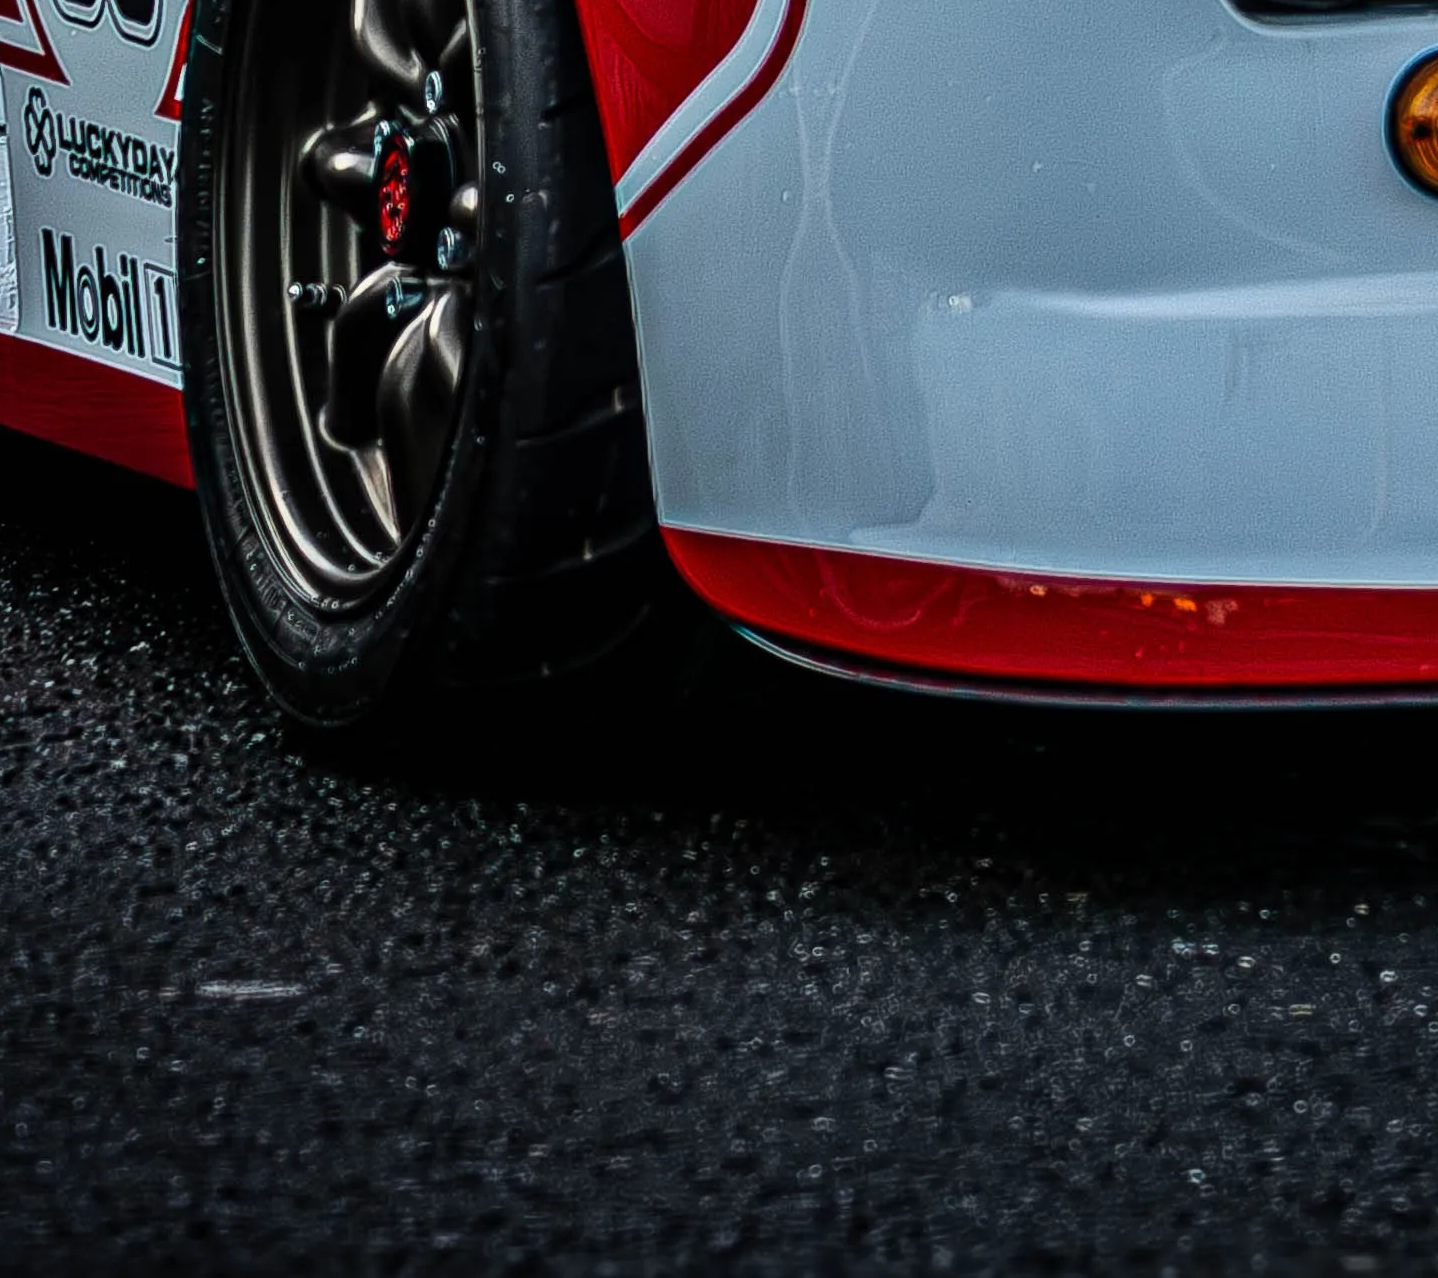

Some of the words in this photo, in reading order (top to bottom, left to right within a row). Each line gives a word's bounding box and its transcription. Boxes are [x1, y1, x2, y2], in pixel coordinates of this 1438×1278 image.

[56, 112, 176, 187] LUCKYDAY
[67, 150, 174, 209] COMPETITIONS
[40, 227, 146, 360] Mobil
